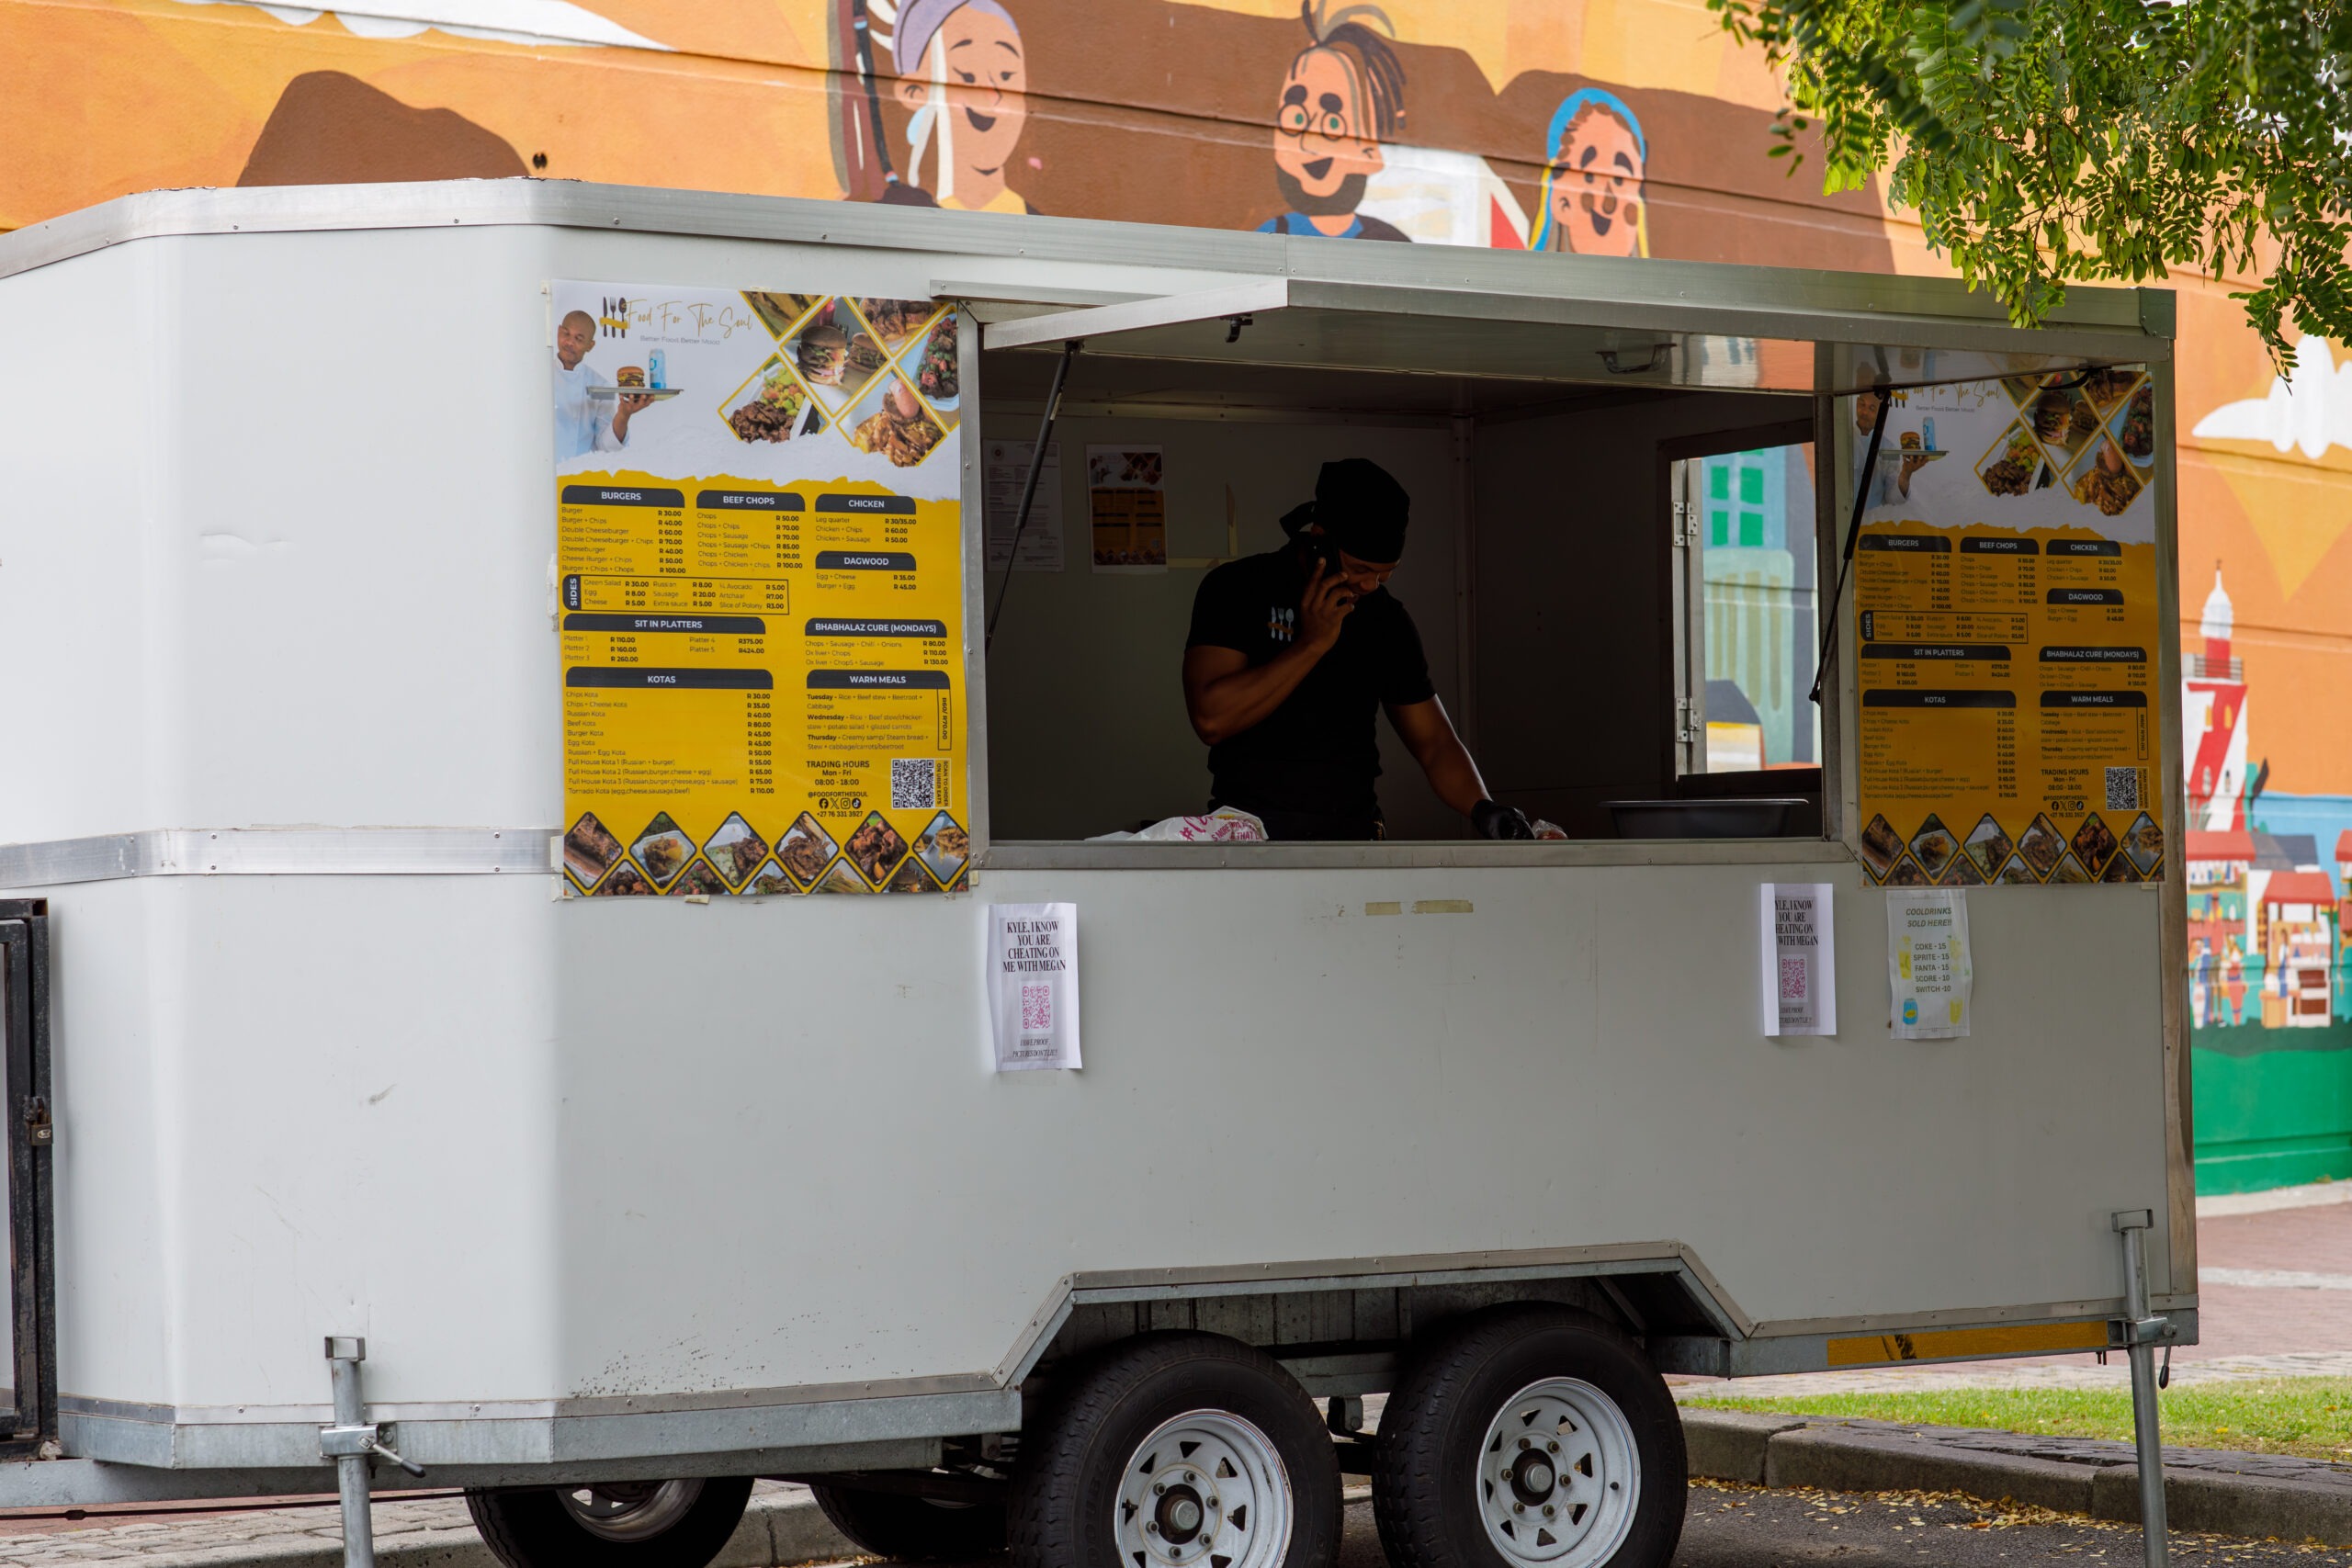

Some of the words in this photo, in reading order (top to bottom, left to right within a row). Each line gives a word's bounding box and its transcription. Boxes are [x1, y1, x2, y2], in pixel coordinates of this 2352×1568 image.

[657, 301, 682, 331] For
[688, 303, 713, 336] The
[718, 307, 752, 338] Soul
[601, 491, 641, 501] BURGERS
[746, 496, 775, 505] CHOPS
[849, 500, 884, 508] CHICKEN
[1888, 539, 1918, 547] BURGERS
[1979, 541, 1994, 549] BEEF
[1996, 542, 2018, 550] CHOPS
[2070, 544, 2098, 552] CHICKEN
[844, 558, 889, 566] DAGWOOD
[891, 625, 936, 634] (MONDAYS)
[2104, 650, 2139, 659] (MONDAYS)
[937, 763, 941, 772] ON
[944, 777, 948, 785] TO
[1775, 900, 1789, 910] YLE,
[1793, 900, 1813, 910] KNOW
[1779, 912, 1792, 921] YOU
[1794, 912, 1805, 921] ARE
[1906, 908, 1951, 916] COOLDRINKS
[1007, 922, 1030, 933] KYLE,
[1032, 921, 1034, 932] I
[1035, 920, 1058, 932] KNOW
[1776, 924, 1803, 933] HEATING
[1804, 924, 1813, 933] ON
[1018, 934, 1034, 946] YOU
[1035, 934, 1051, 945] ARE
[1779, 936, 1795, 945] WITH
[1796, 936, 1818, 945] MEGAN
[1008, 947, 1047, 959] CHEATING
[1049, 946, 1059, 958] ON
[1003, 962, 1015, 972] ME
[1017, 961, 1037, 972] WITH
[1039, 960, 1066, 971] MEGAN
